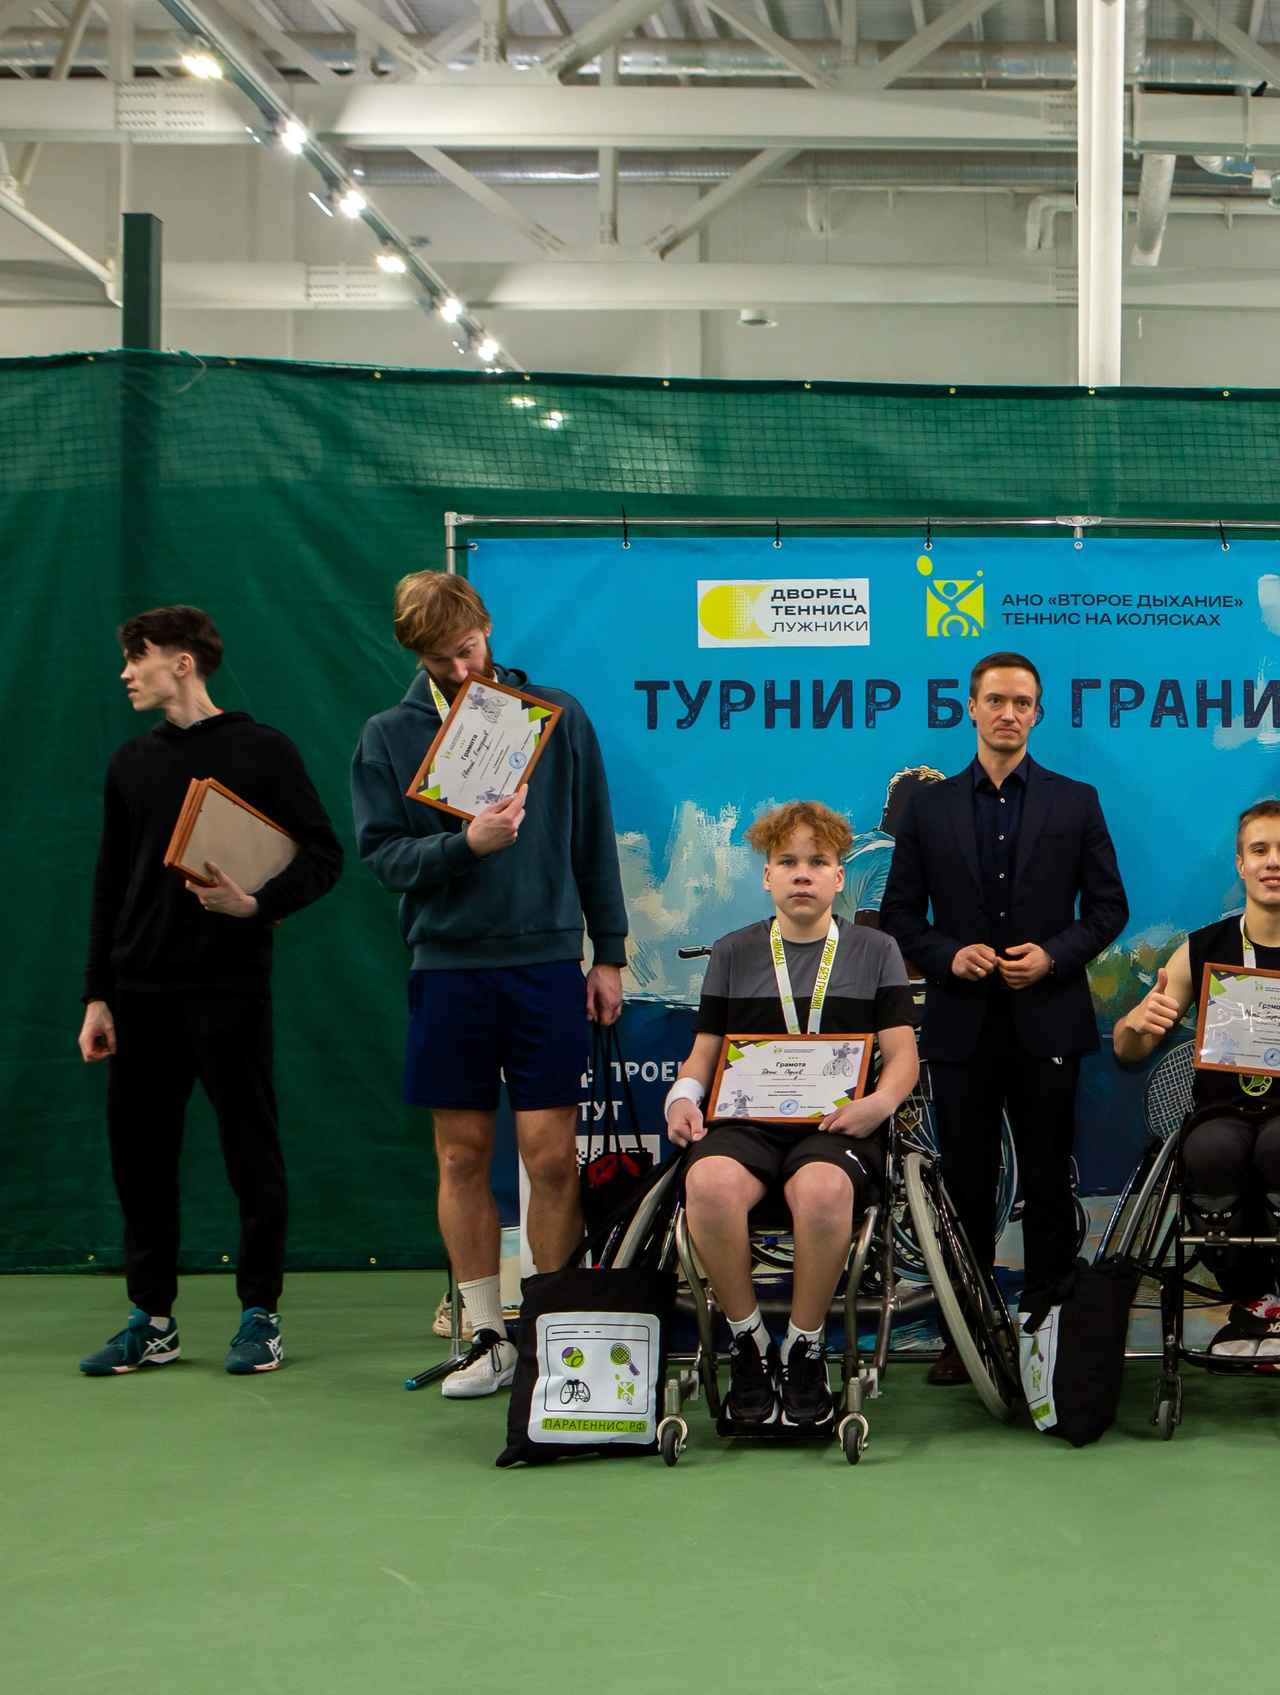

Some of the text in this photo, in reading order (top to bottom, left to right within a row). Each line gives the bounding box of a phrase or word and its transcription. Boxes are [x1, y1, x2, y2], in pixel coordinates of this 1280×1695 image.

[771, 588, 857, 602] ДВОРЕЦ
[1001, 594, 1243, 609] АНО «ВТОРОЕ ДЫХАНИЕ»
[771, 604, 867, 616] ТЕННИСА
[1001, 612, 1221, 626] ТЕННИС НА КОЛЯСКАХ
[771, 620, 868, 633] ЛУЖНИКИ
[634, 679, 901, 731] ТУРНИР
[461, 734, 479, 762] Грамота
[772, 939, 786, 968] ТУРНИР
[822, 938, 837, 968] ТУРНИР
[809, 980, 827, 1010] ГРАНИЦ
[610, 1061, 684, 1083] ПРОЕ
[775, 1061, 806, 1069] Грамота
[577, 1100, 623, 1122] ТУТ
[544, 1418, 647, 1432] ПАРАТЕННИС.РФ
